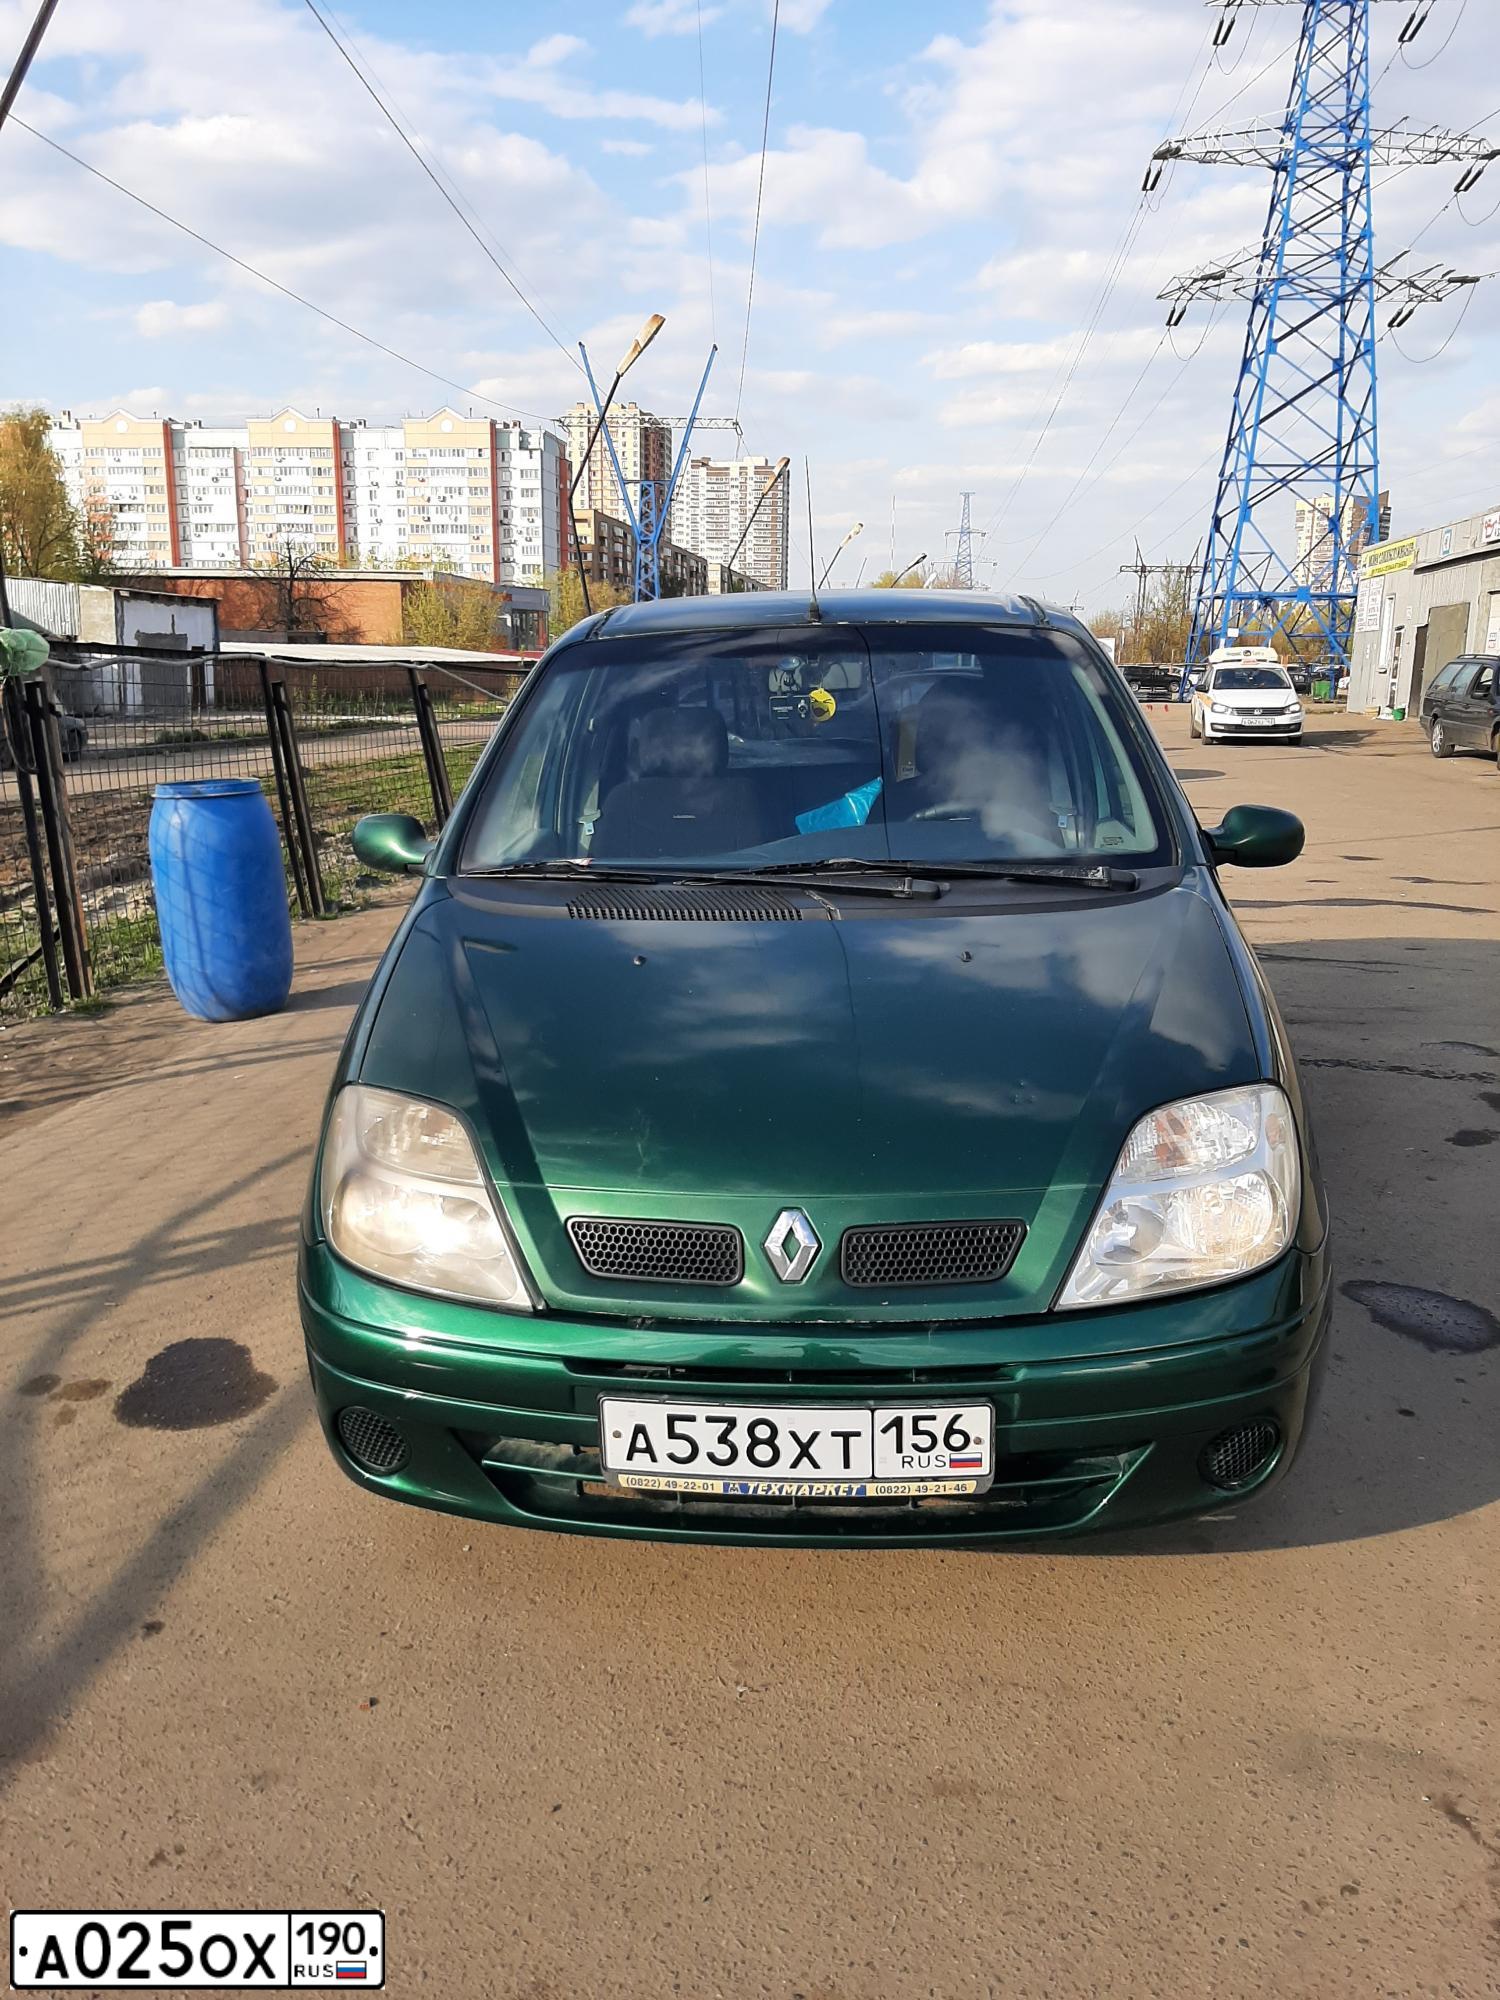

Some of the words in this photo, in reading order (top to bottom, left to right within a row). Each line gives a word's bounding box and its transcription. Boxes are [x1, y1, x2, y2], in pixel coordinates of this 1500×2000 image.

[625, 1413, 862, 1470] А538ХТ
[880, 1413, 971, 1453] 156
[901, 1453, 947, 1469] RUS
[626, 1477, 661, 1489] (0822)
[664, 1479, 714, 1491] 49-22-01
[747, 1482, 861, 1496] ТЕХМАРКЕТ
[875, 1485, 911, 1495] (0822)
[915, 1482, 968, 1493] 49-21-46
